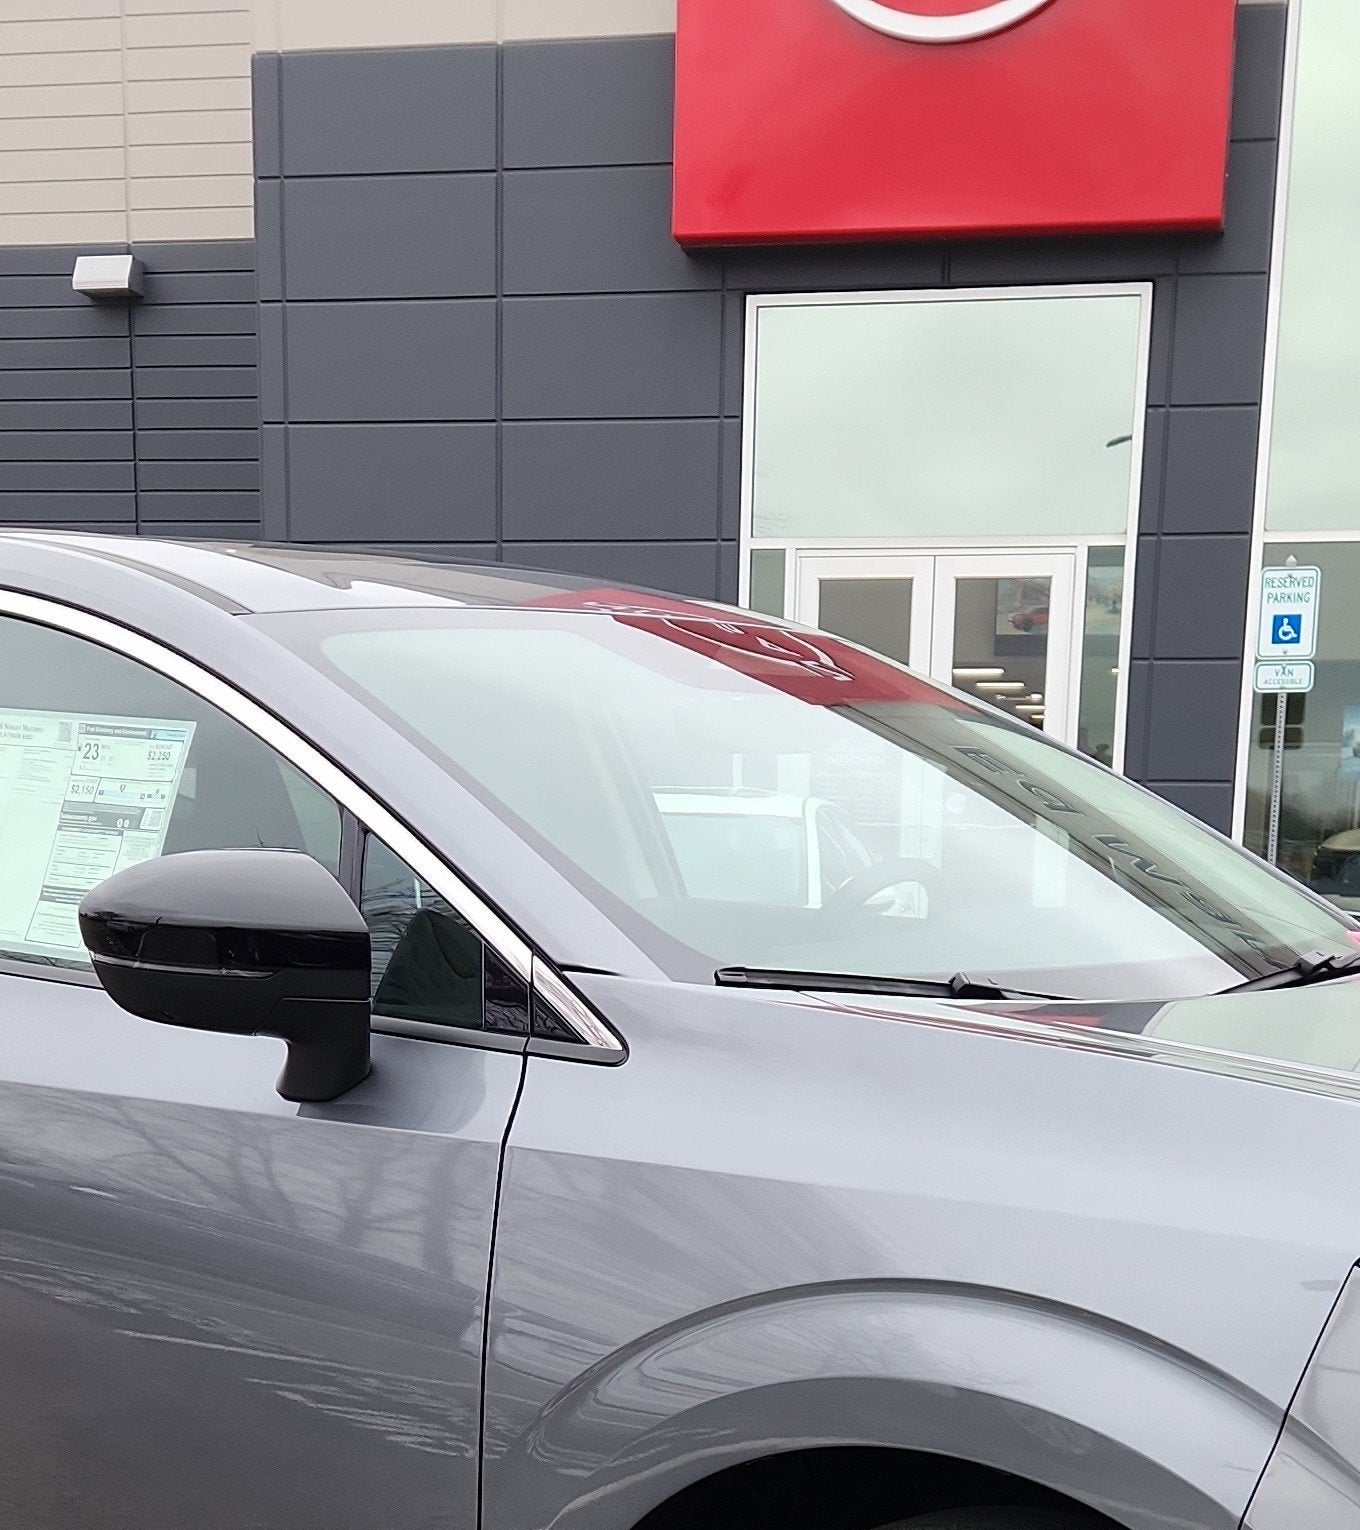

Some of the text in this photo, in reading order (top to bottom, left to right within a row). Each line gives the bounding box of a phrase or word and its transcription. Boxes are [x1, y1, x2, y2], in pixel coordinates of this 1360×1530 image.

[1264, 576, 1315, 589] RESERVED
[1266, 591, 1311, 604] PARKING
[1274, 667, 1294, 678] VAN
[1263, 678, 1303, 686] ACCESSIBLE
[82, 742, 100, 761] 23
